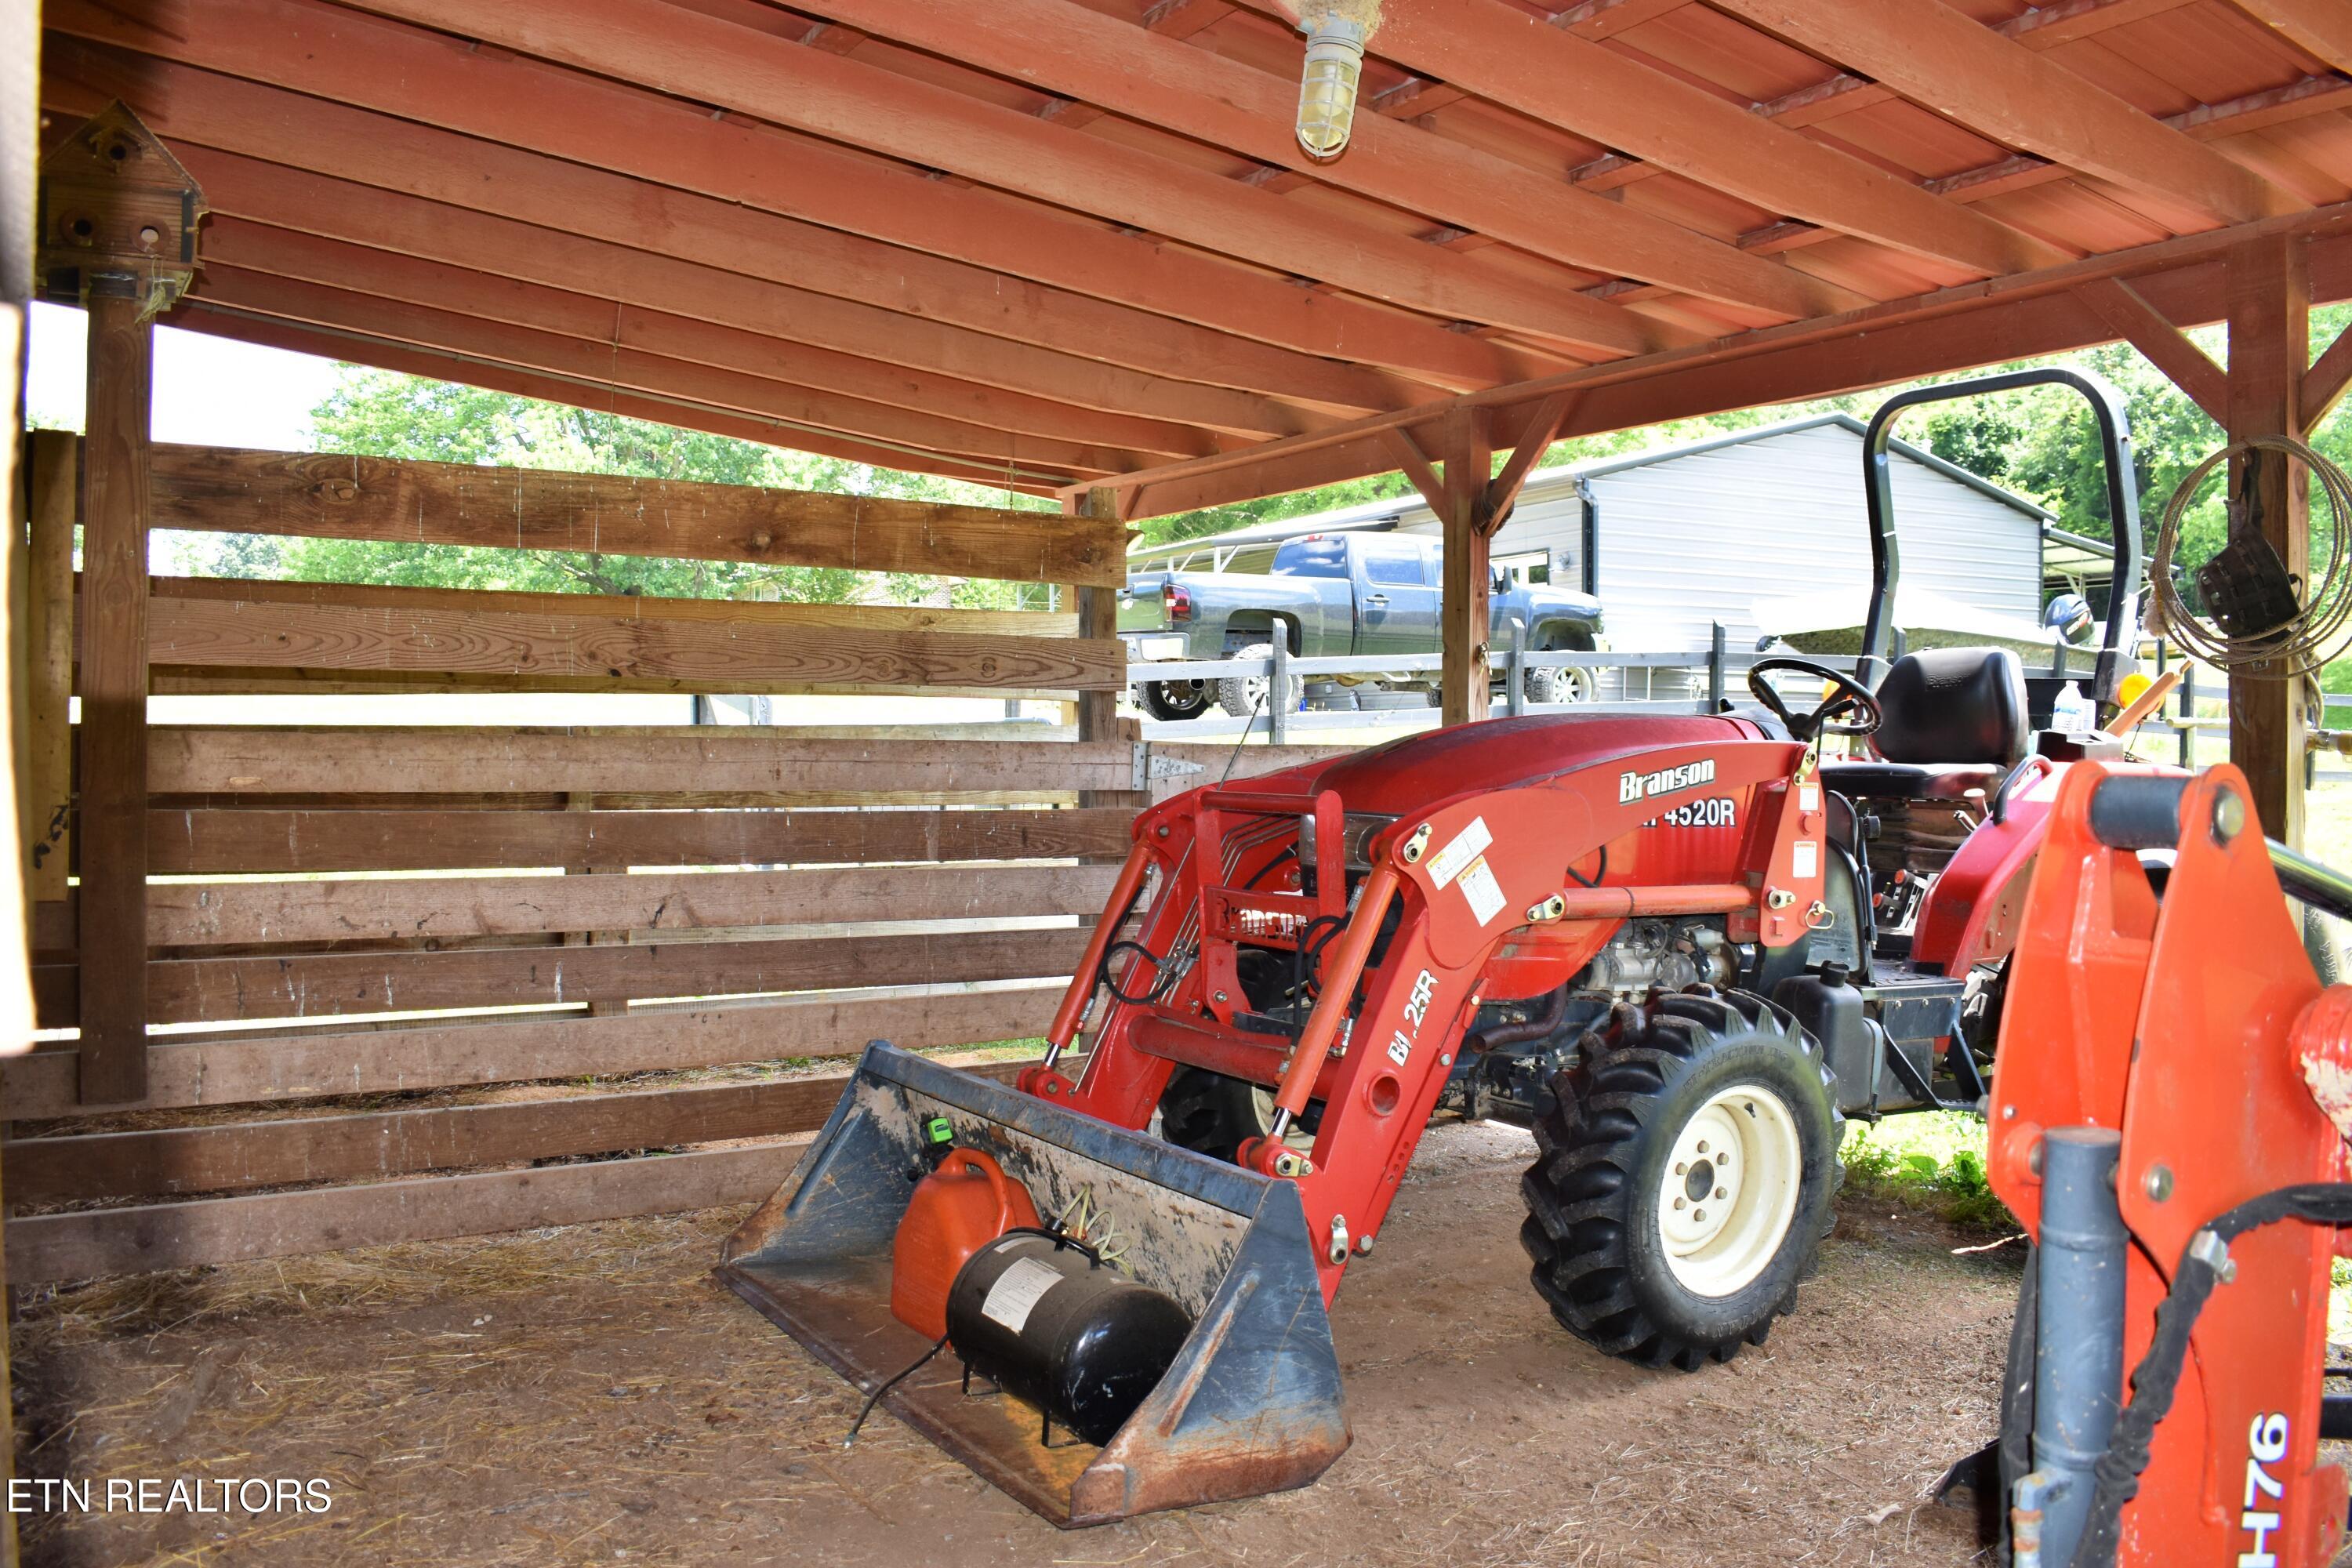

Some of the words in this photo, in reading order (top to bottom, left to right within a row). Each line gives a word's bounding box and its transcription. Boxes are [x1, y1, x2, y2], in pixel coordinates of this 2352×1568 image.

[1619, 759, 1715, 804] Branson
[1664, 798, 1736, 826] 4520R
[1403, 968, 1439, 1029] 25R
